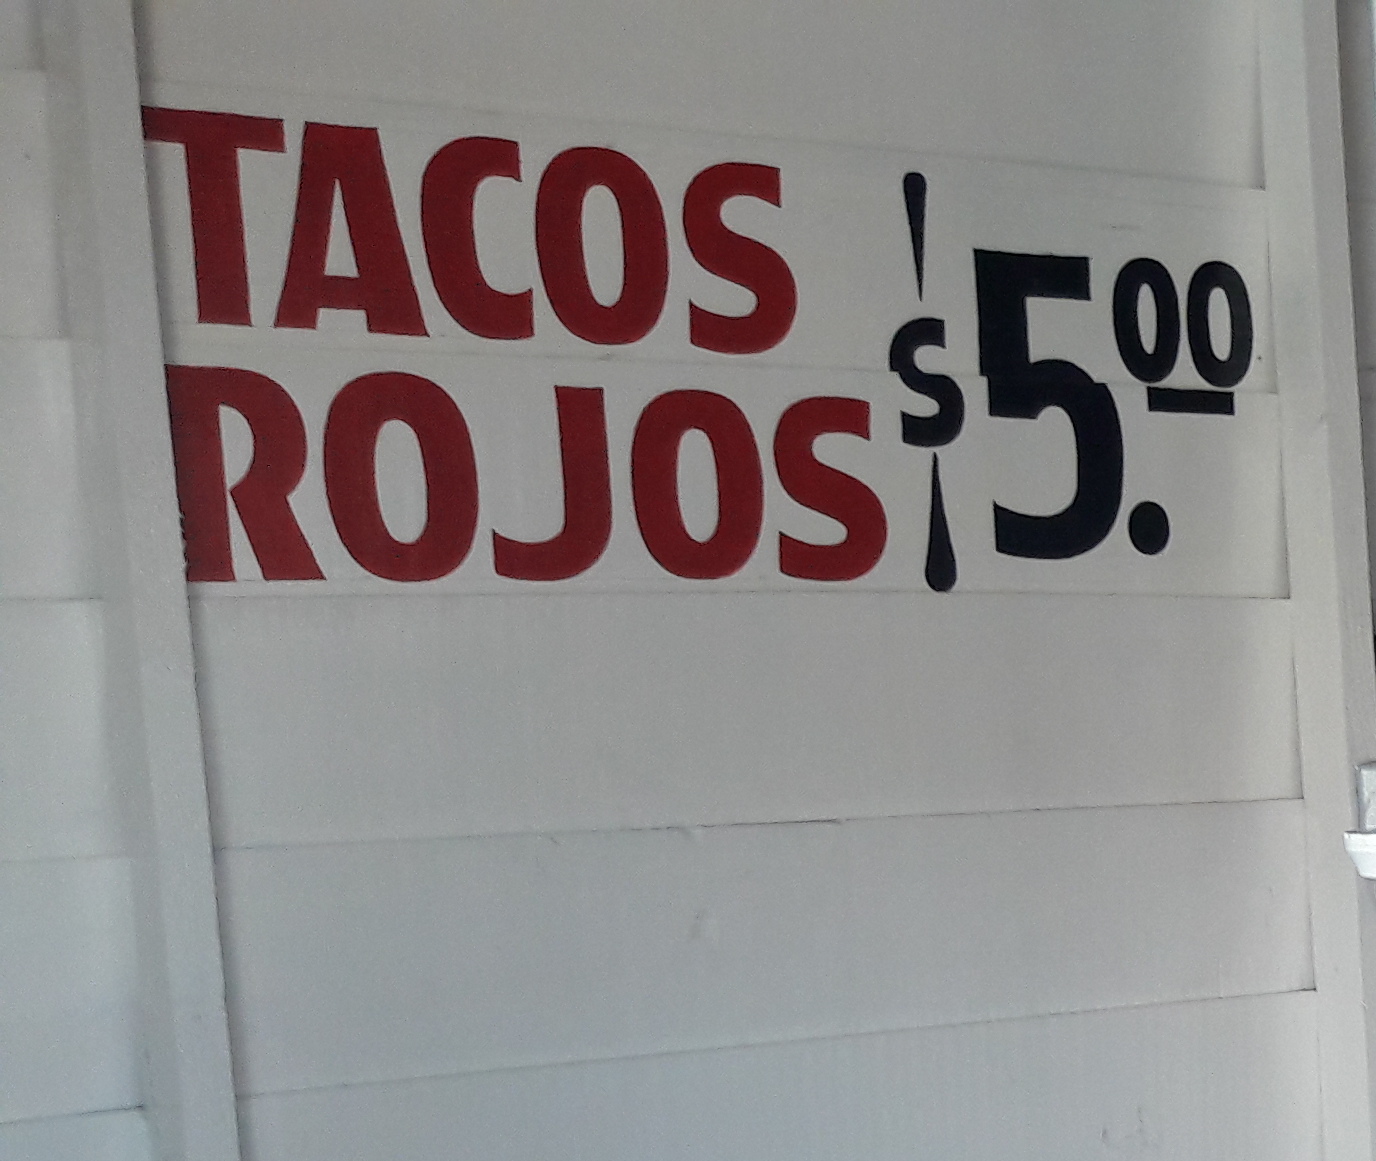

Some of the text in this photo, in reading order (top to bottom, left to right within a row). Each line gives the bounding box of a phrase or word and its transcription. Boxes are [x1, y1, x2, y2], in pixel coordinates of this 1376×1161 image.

[142, 107, 797, 353] TACOS
[164, 363, 888, 582] ROJOS
[887, 171, 1254, 593] $5.00
